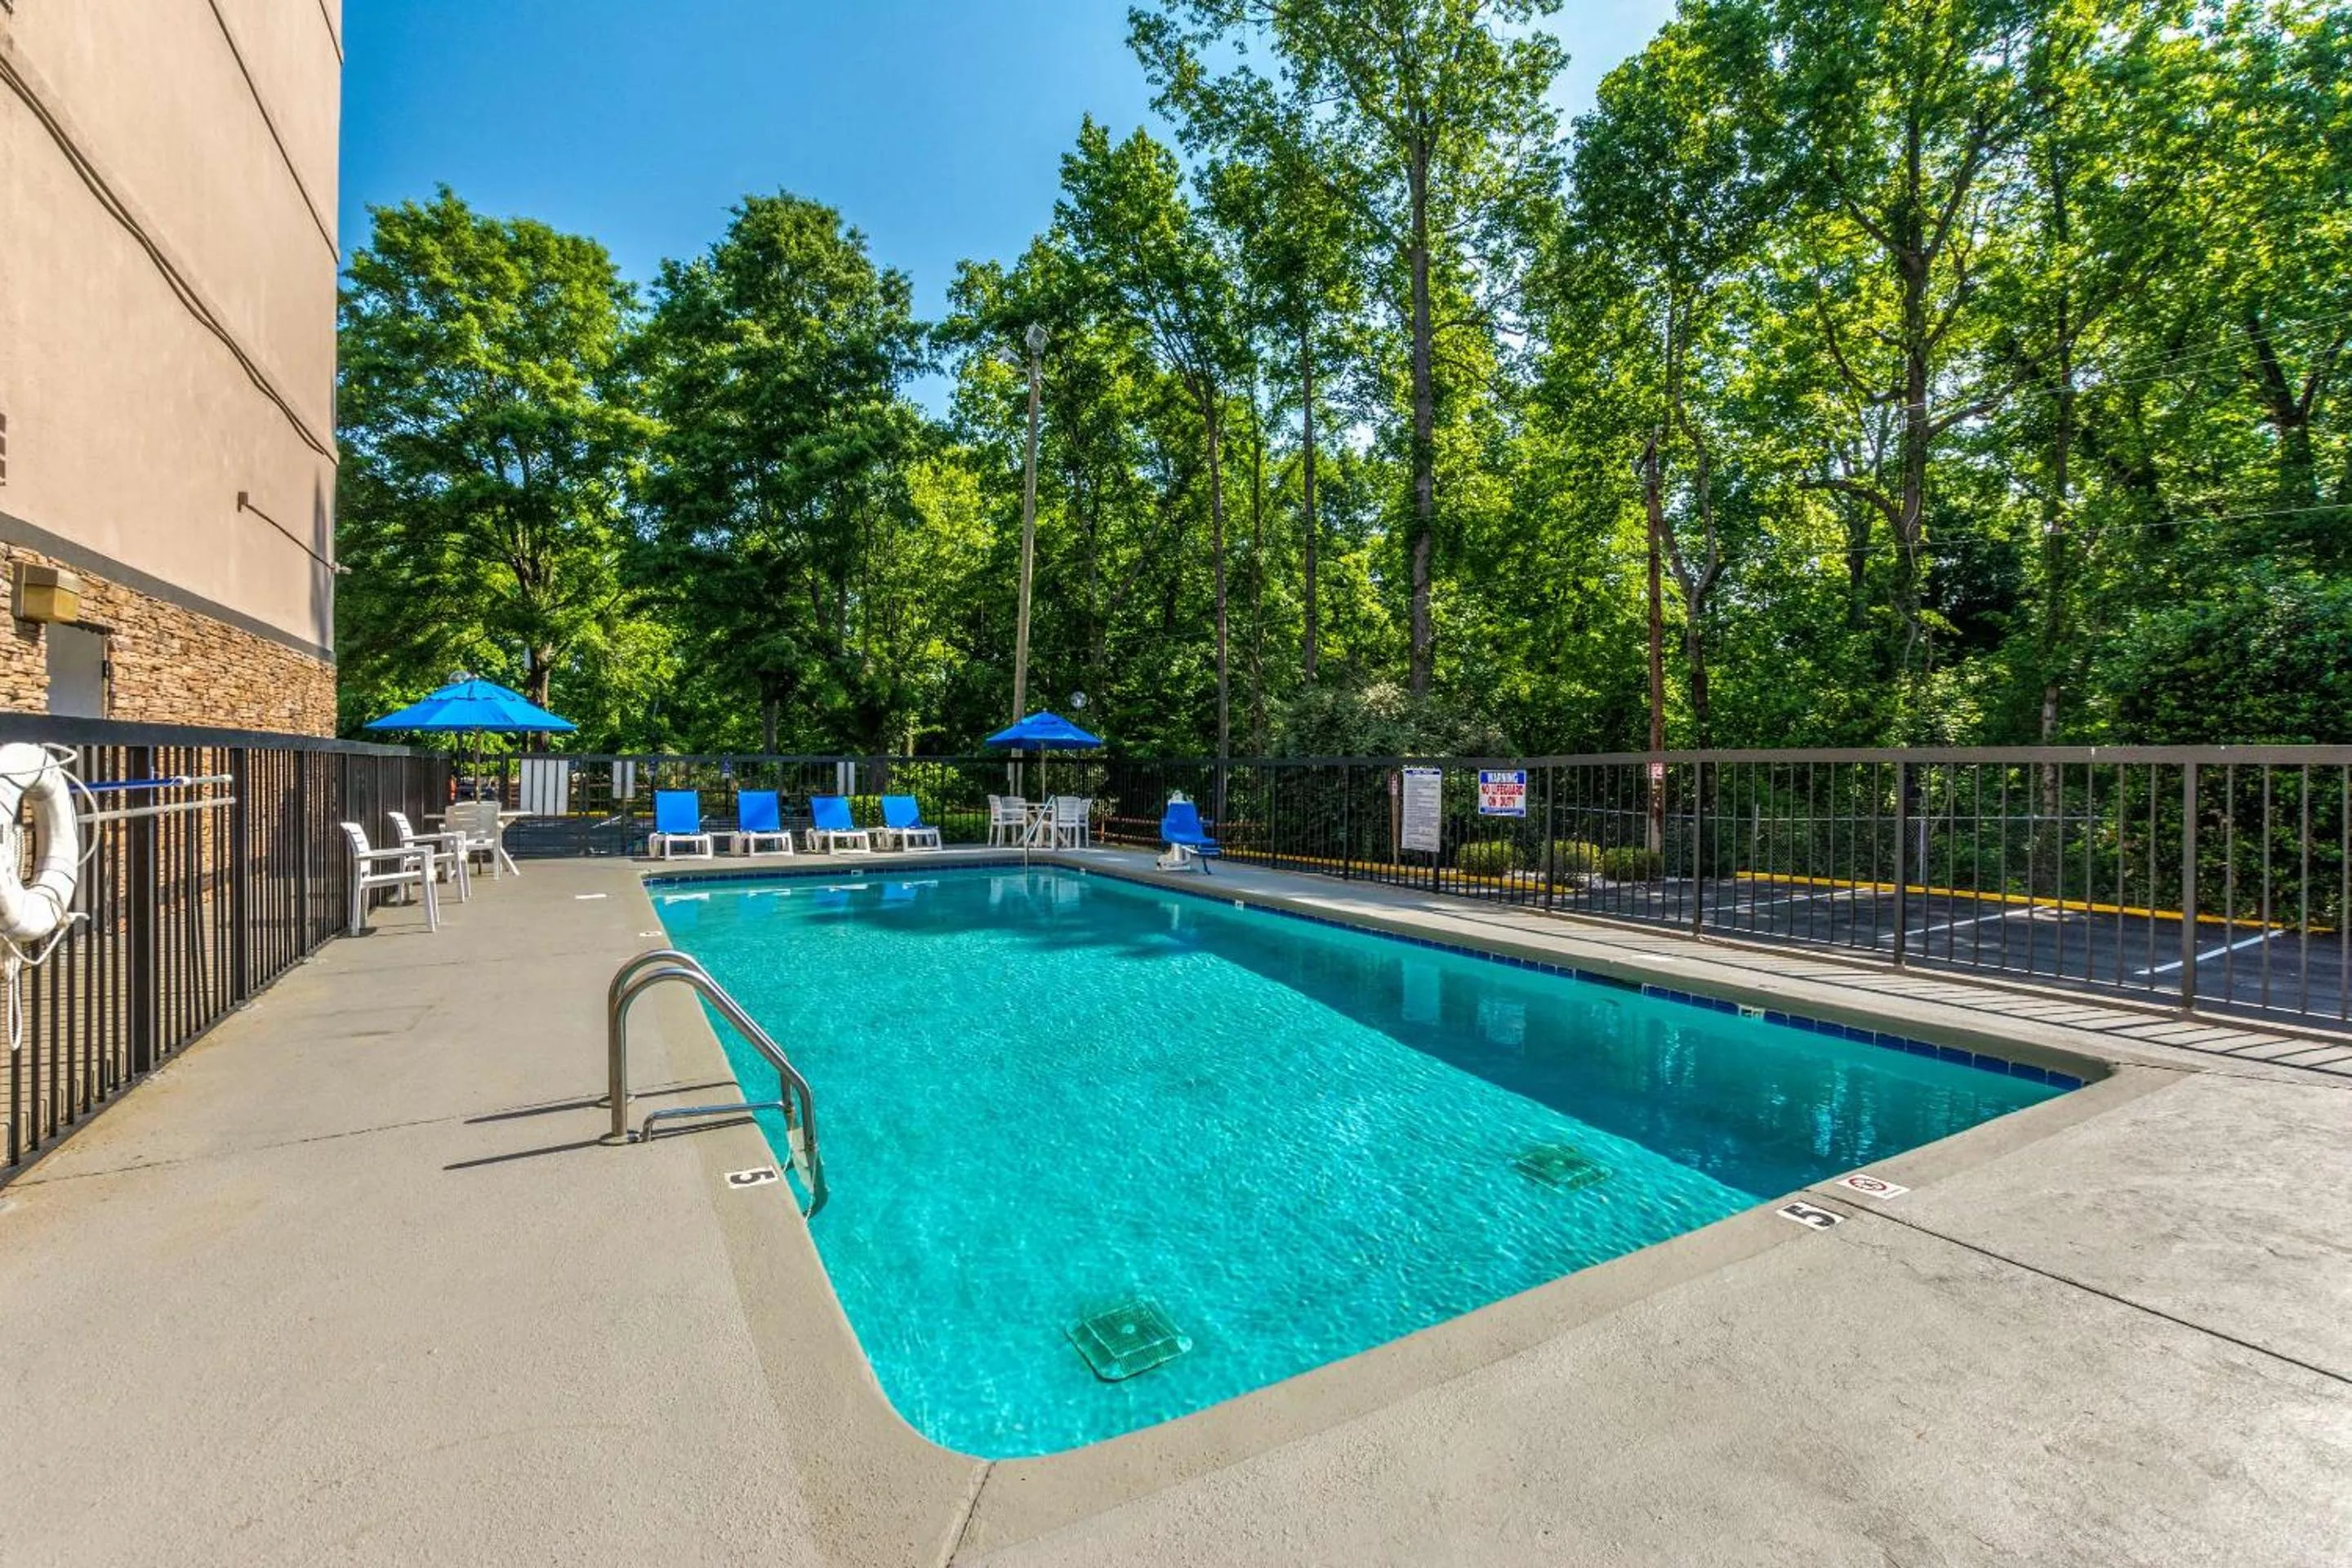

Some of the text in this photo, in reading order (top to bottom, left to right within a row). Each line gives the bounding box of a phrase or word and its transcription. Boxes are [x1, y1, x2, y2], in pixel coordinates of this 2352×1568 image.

[1481, 785, 1523, 795] NO LIFEGUARD
[1487, 796, 1516, 808] ON DUTY
[730, 1170, 775, 1184] 5
[1783, 1205, 1836, 1227] 5
